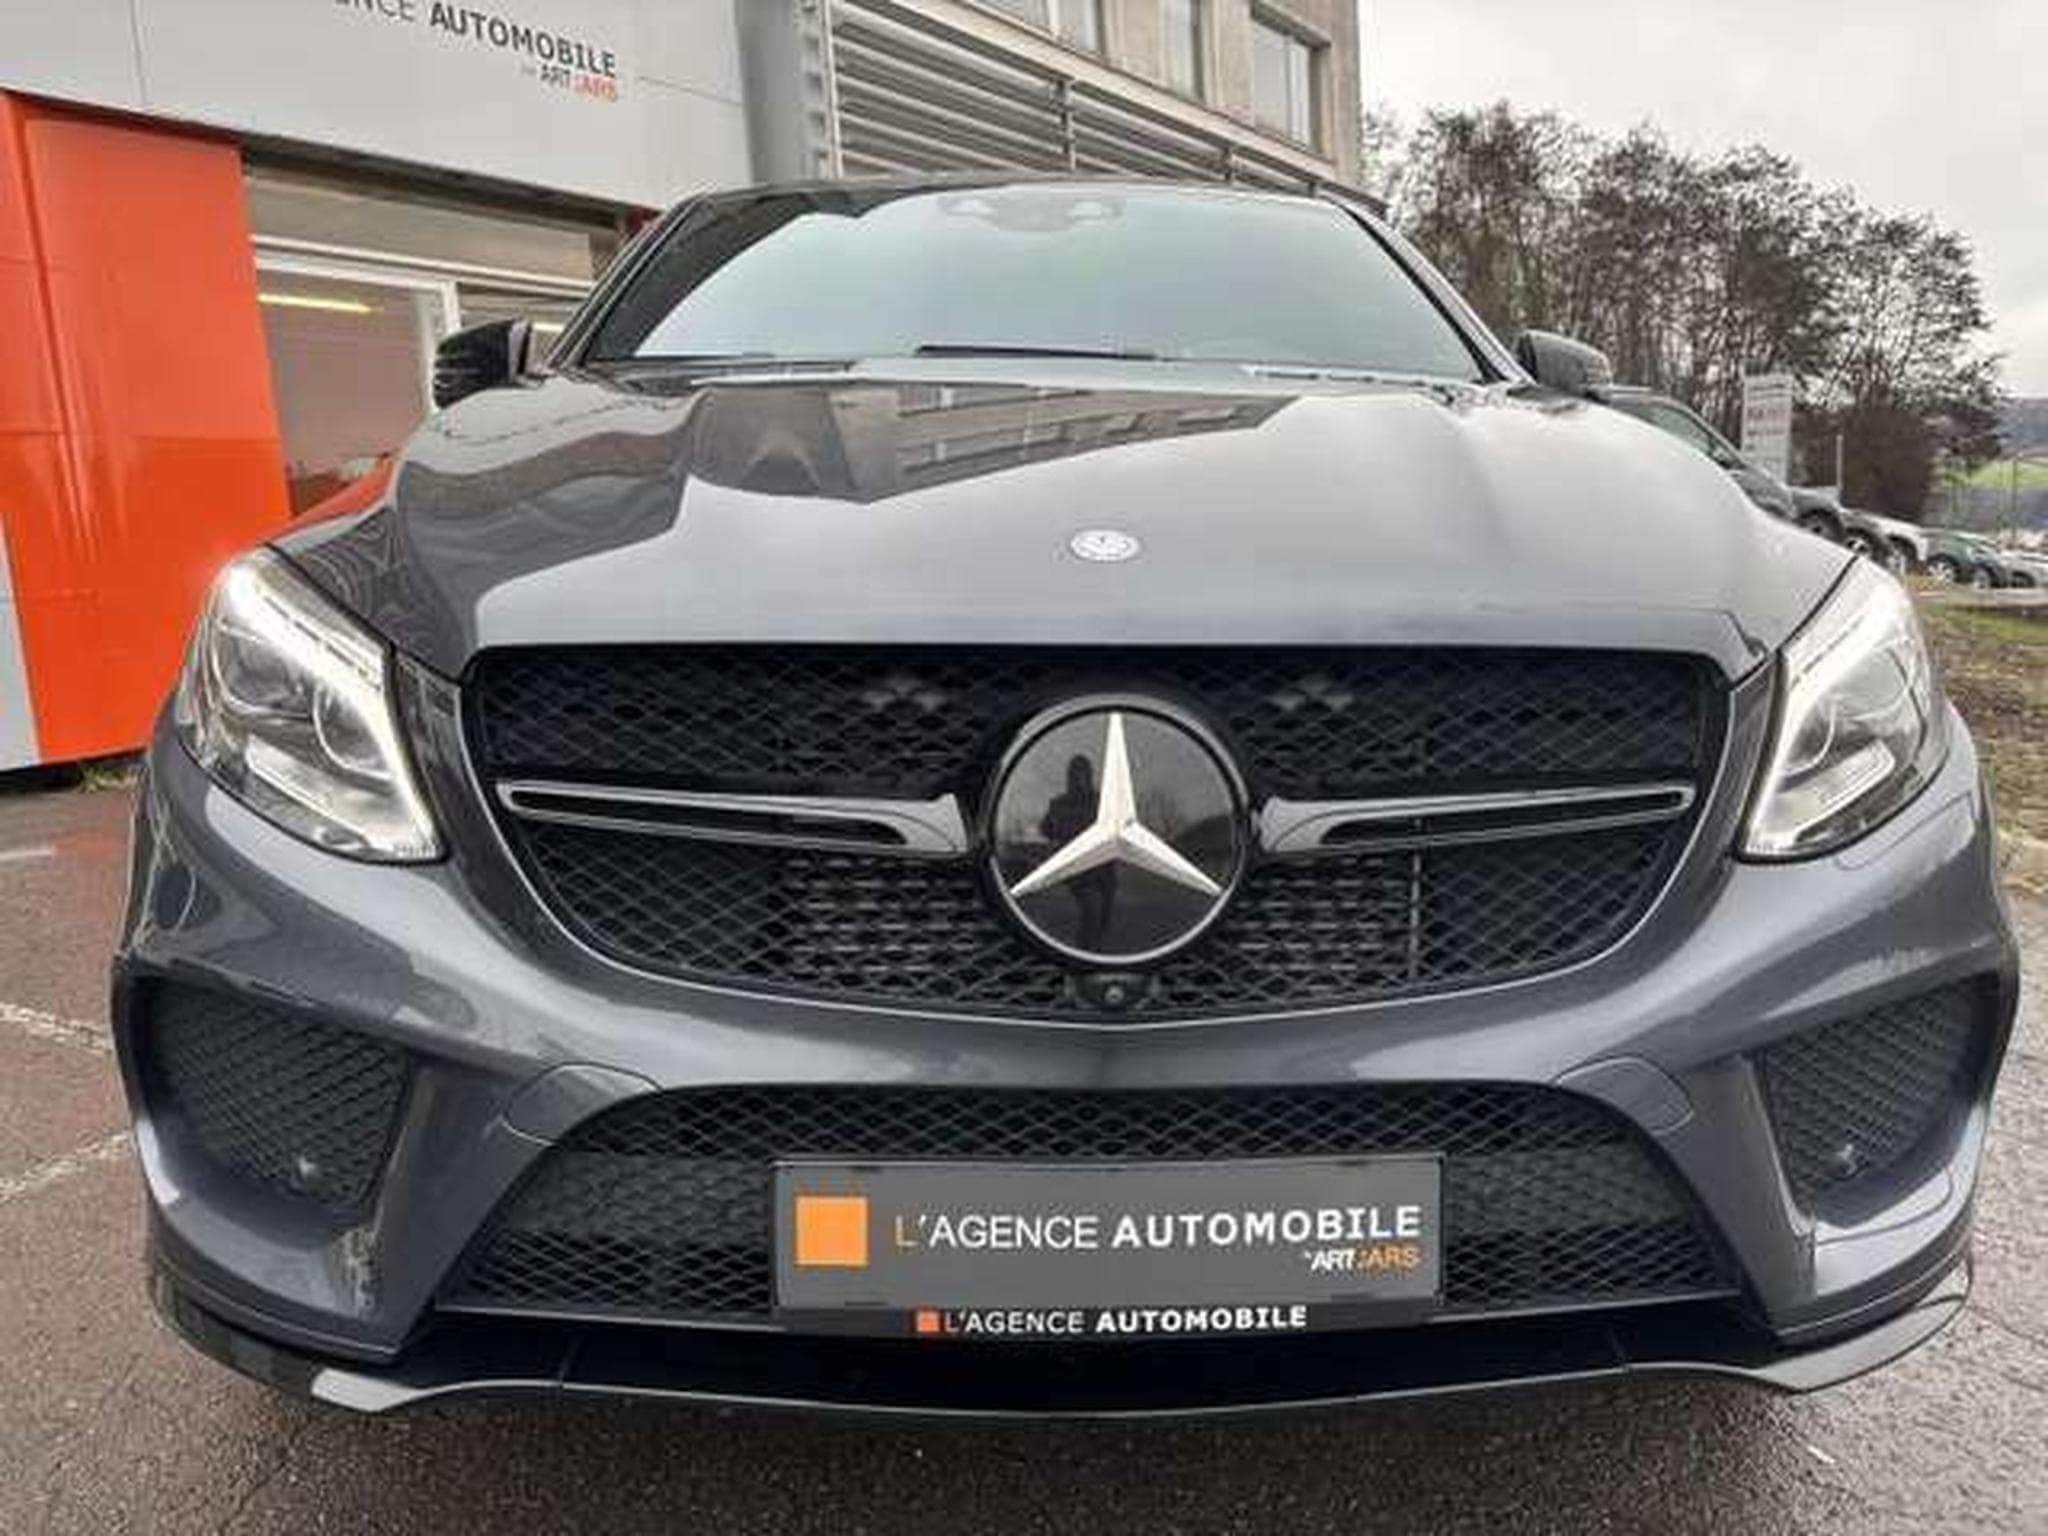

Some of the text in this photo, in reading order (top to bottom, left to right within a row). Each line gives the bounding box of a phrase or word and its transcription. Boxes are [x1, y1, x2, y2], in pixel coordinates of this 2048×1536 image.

[430, 2, 615, 78] AUTOMOBILE
[895, 1205, 1421, 1249] L'AGENCE AUTOMOBILE
[945, 1305, 1307, 1334] L'AGENCE AUTOMOBILE
